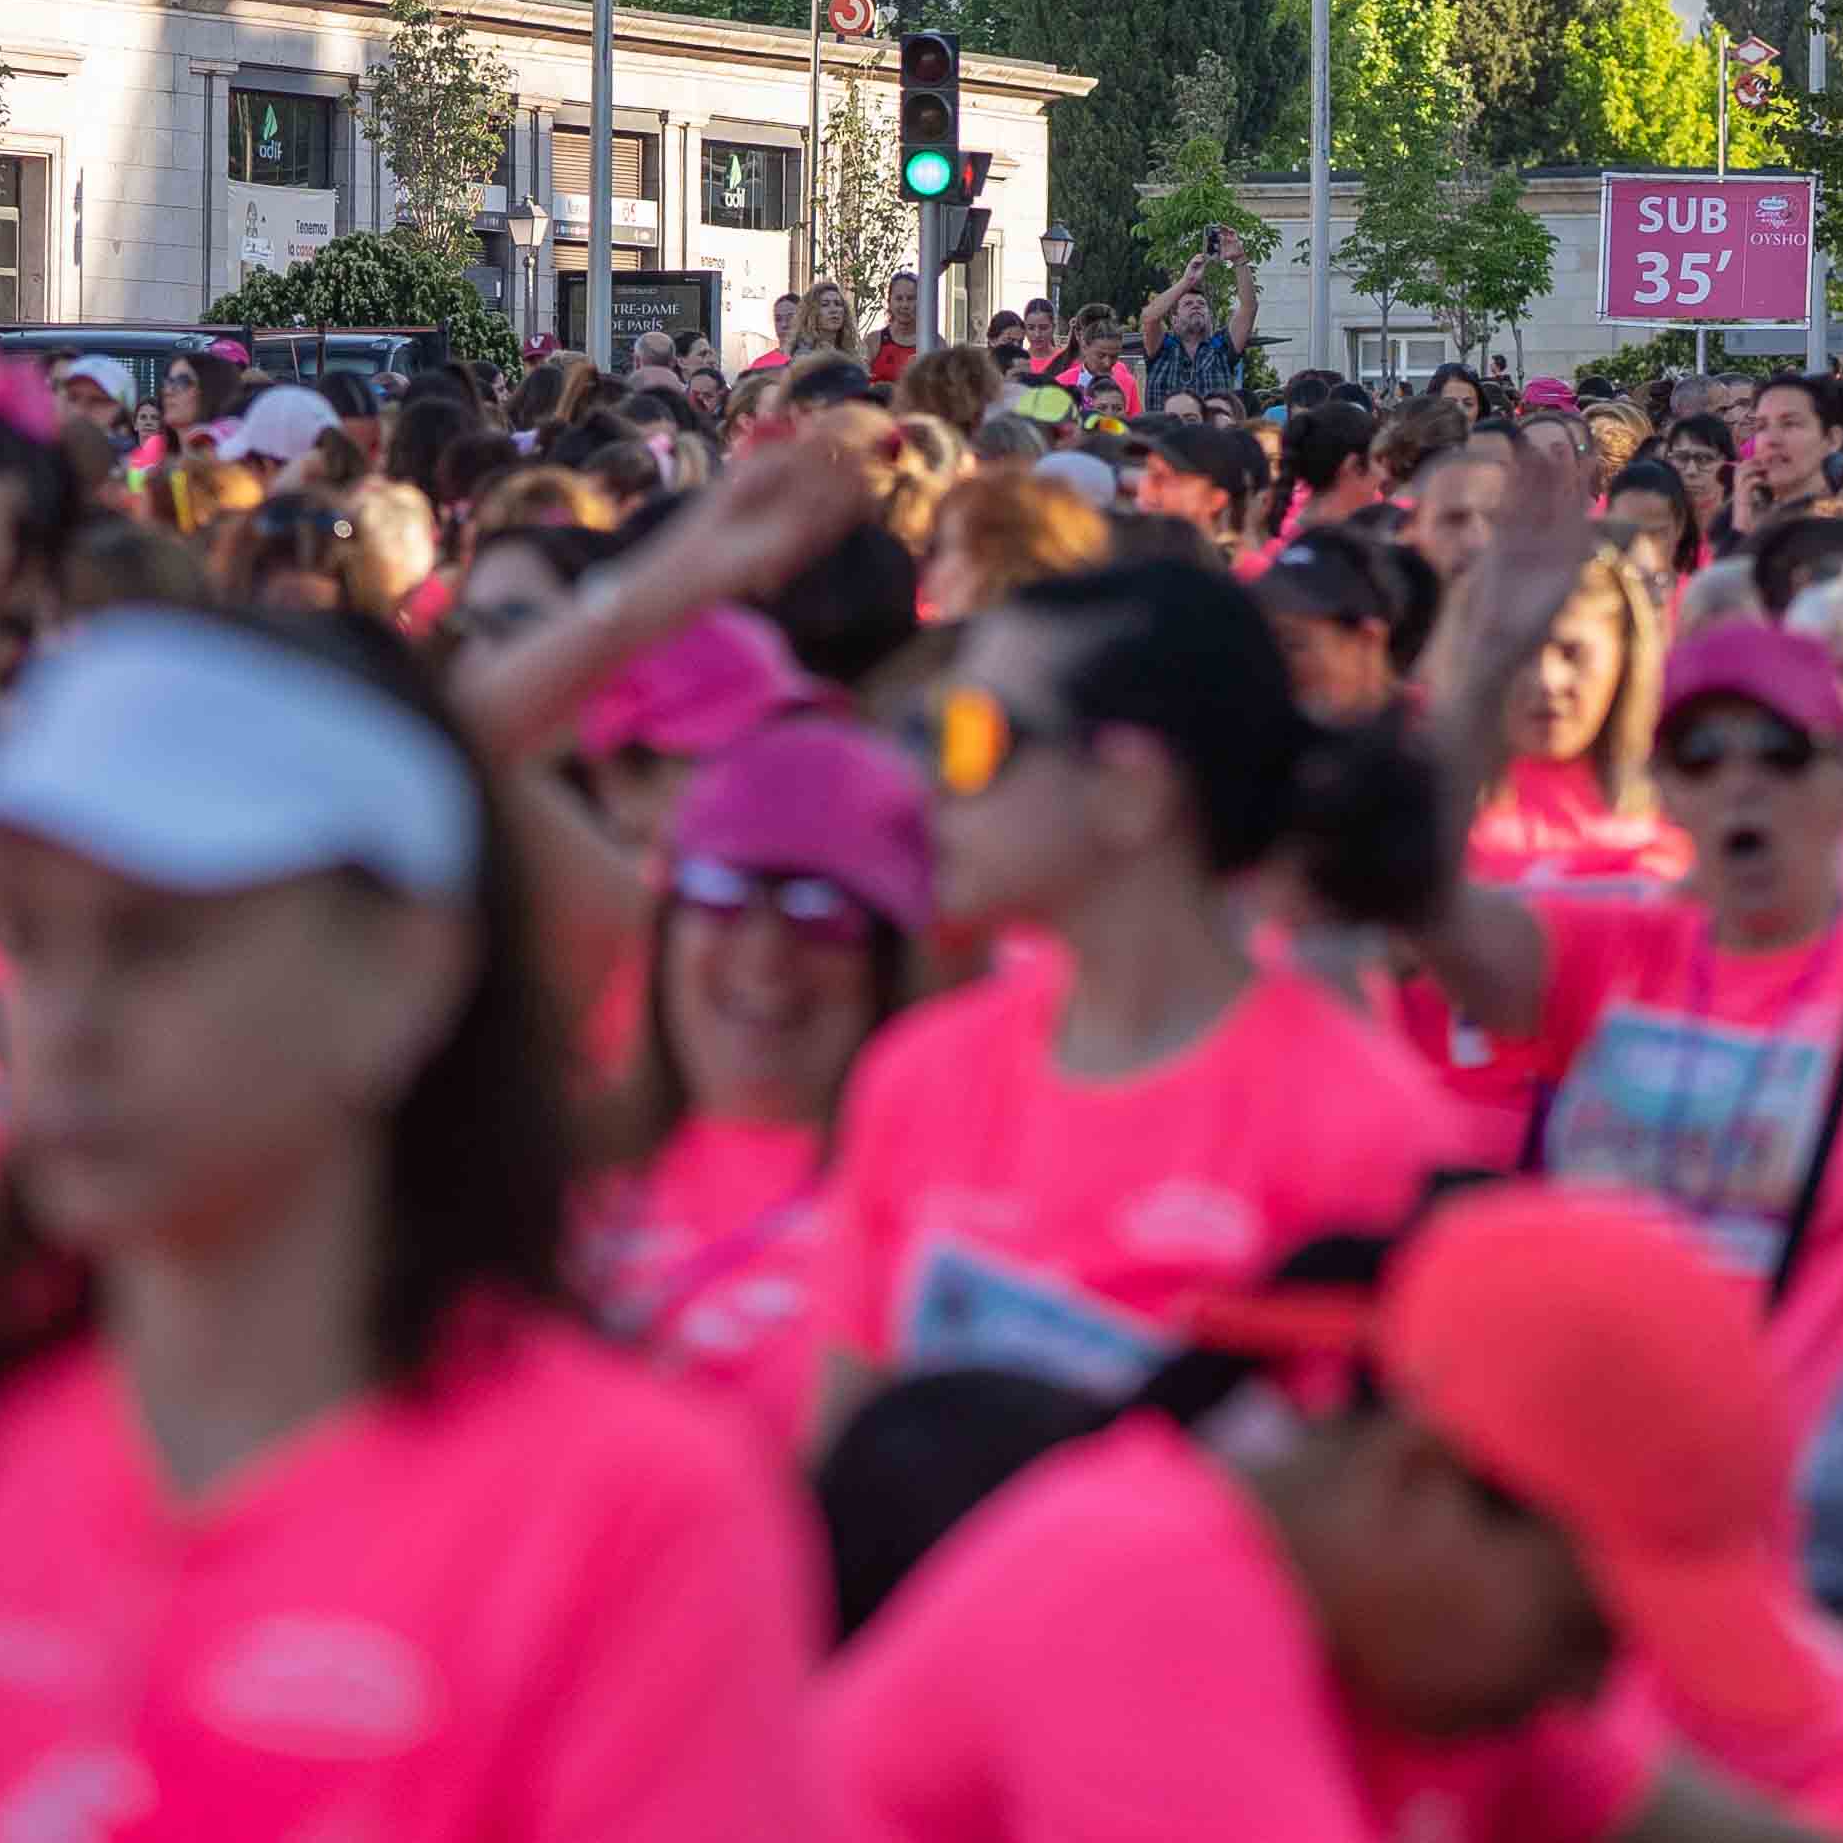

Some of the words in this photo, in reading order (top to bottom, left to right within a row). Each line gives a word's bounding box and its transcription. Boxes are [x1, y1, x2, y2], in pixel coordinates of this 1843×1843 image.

[259, 139, 284, 161] adif
[1637, 196, 1728, 234] SUB
[295, 219, 329, 237] Tenemos
[1750, 232, 1806, 246] OYSHO
[627, 316, 665, 332] PARÍS
